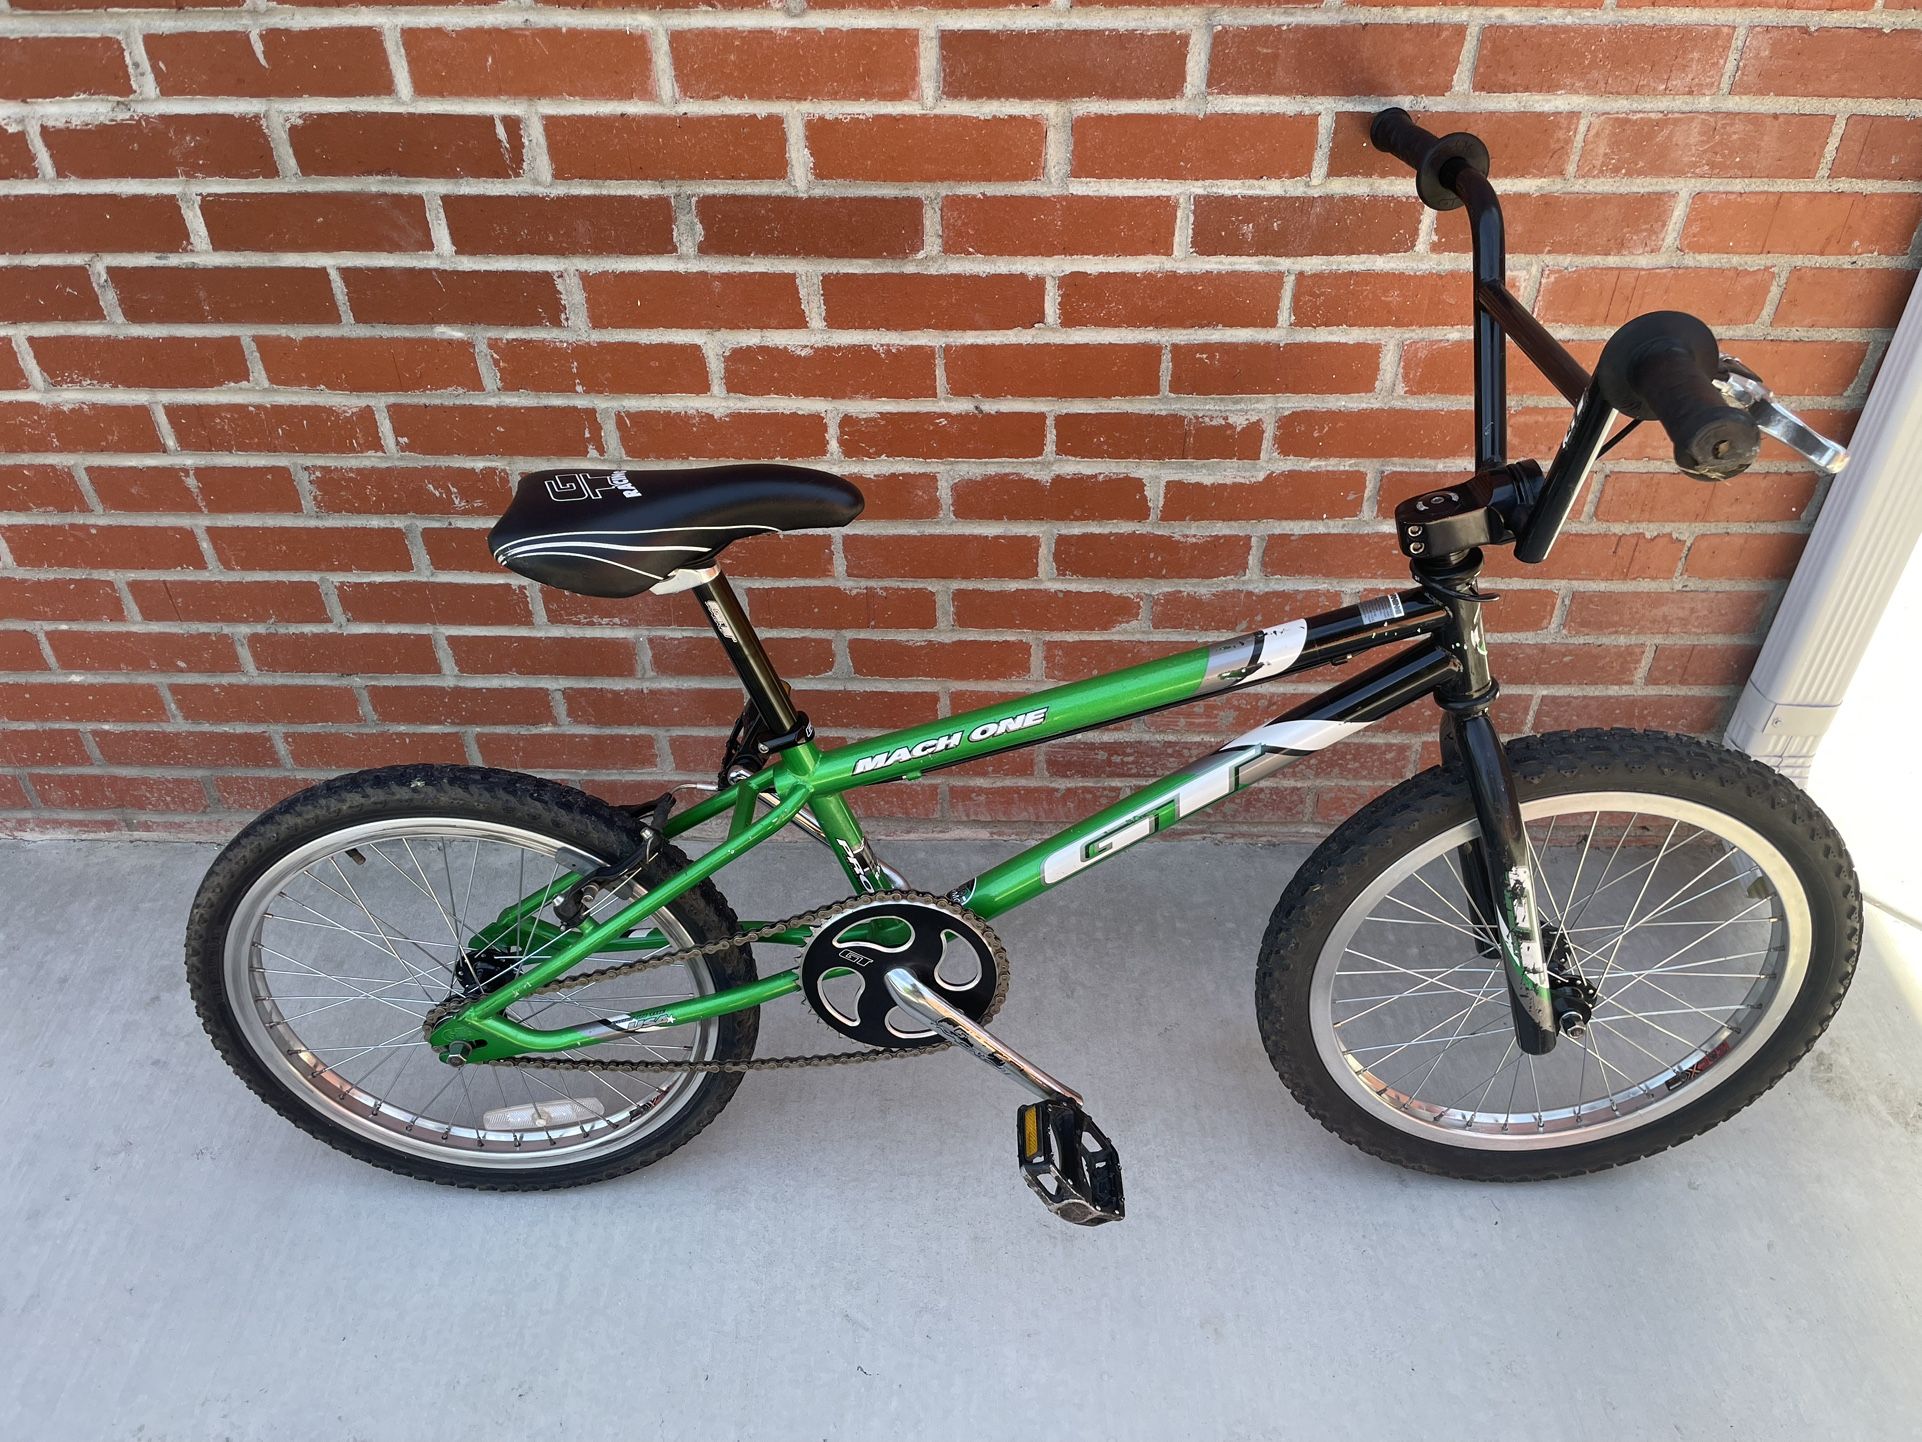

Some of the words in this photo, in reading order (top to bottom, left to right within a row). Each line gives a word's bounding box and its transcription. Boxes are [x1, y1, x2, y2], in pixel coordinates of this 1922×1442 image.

[544, 472, 614, 502] GT
[852, 730, 965, 776] MACH
[968, 706, 1050, 743] ONE
[1040, 742, 1266, 887] GT
[836, 838, 876, 894] PRO
[838, 948, 875, 967] GT
